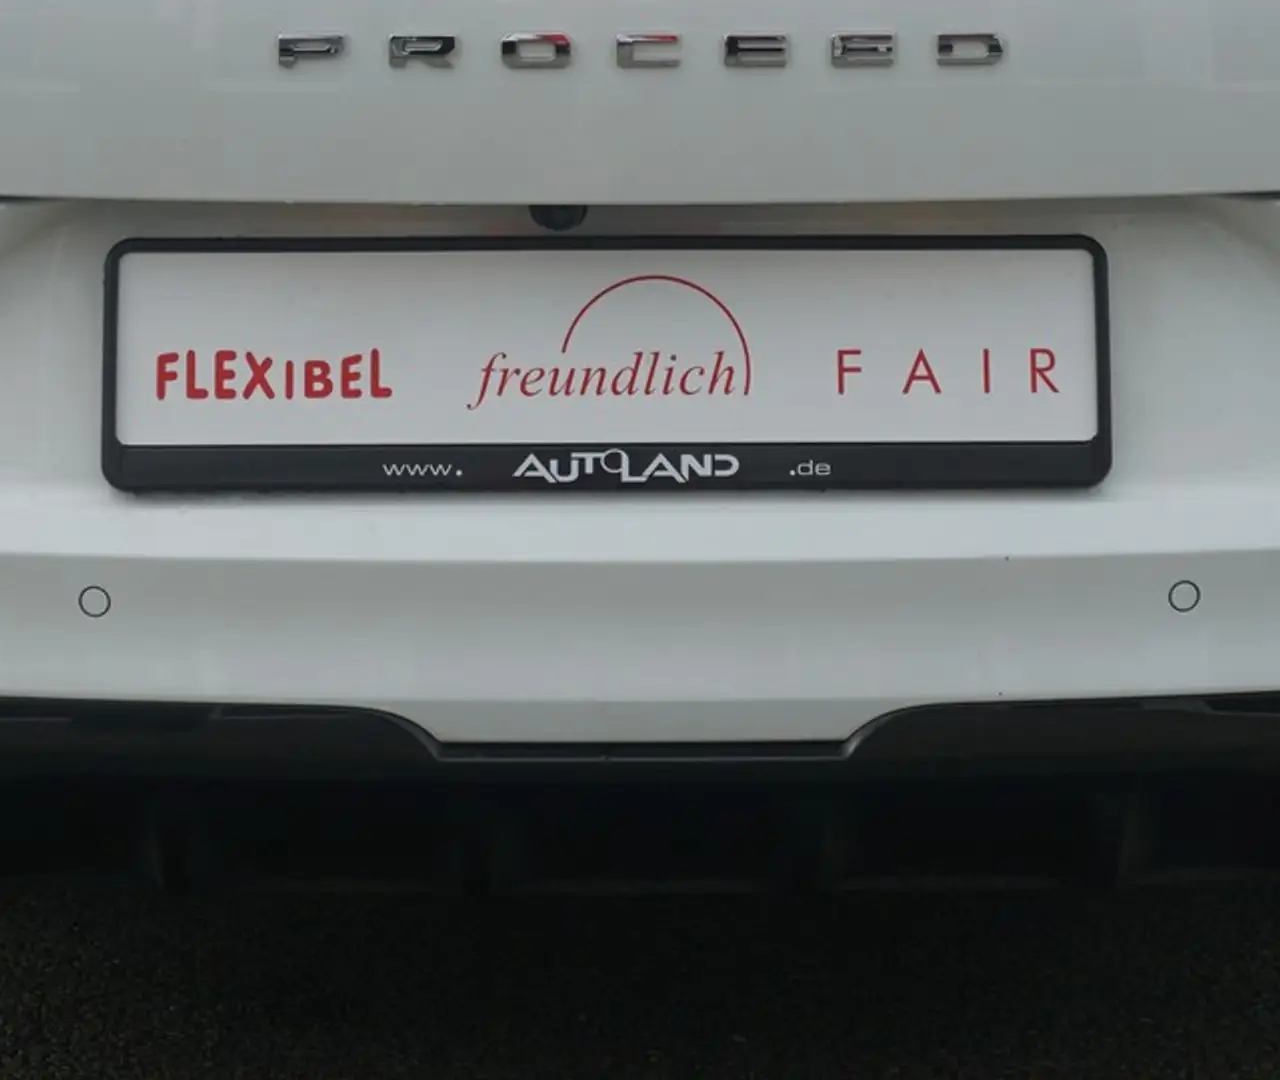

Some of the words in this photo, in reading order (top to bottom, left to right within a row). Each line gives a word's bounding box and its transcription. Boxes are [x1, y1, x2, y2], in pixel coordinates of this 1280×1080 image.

[278, 33, 1006, 69] PROCEED
[467, 350, 739, 409] freundlich
[836, 347, 1061, 395] FAIR
[382, 462, 464, 477] www.
[512, 448, 740, 484] AUTOLAND
[788, 459, 832, 476] .de
